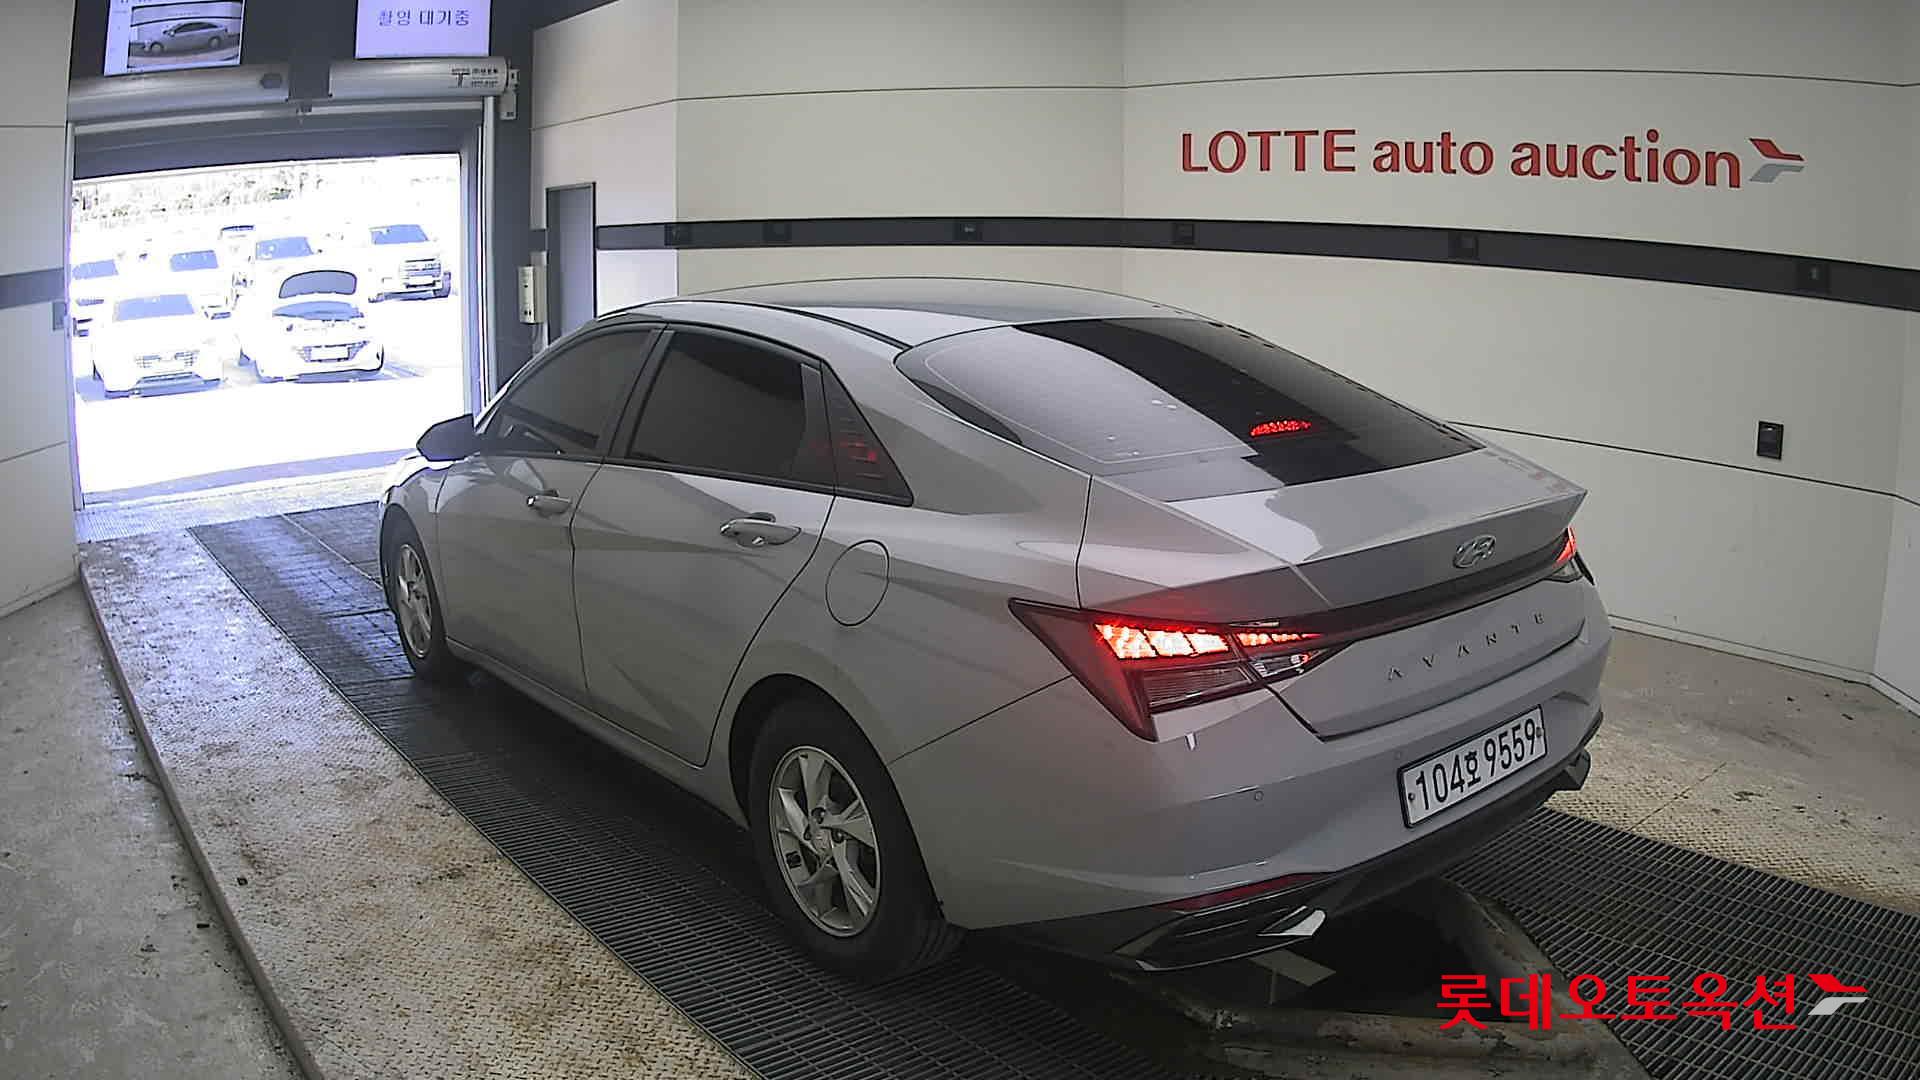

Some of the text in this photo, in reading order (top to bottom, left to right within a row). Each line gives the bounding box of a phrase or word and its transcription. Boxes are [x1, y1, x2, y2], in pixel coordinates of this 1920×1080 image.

[419, 9, 469, 26] 대기중
[1182, 128, 1741, 188] LOTTE auto auction
[1388, 613, 1545, 681] AVANTE
